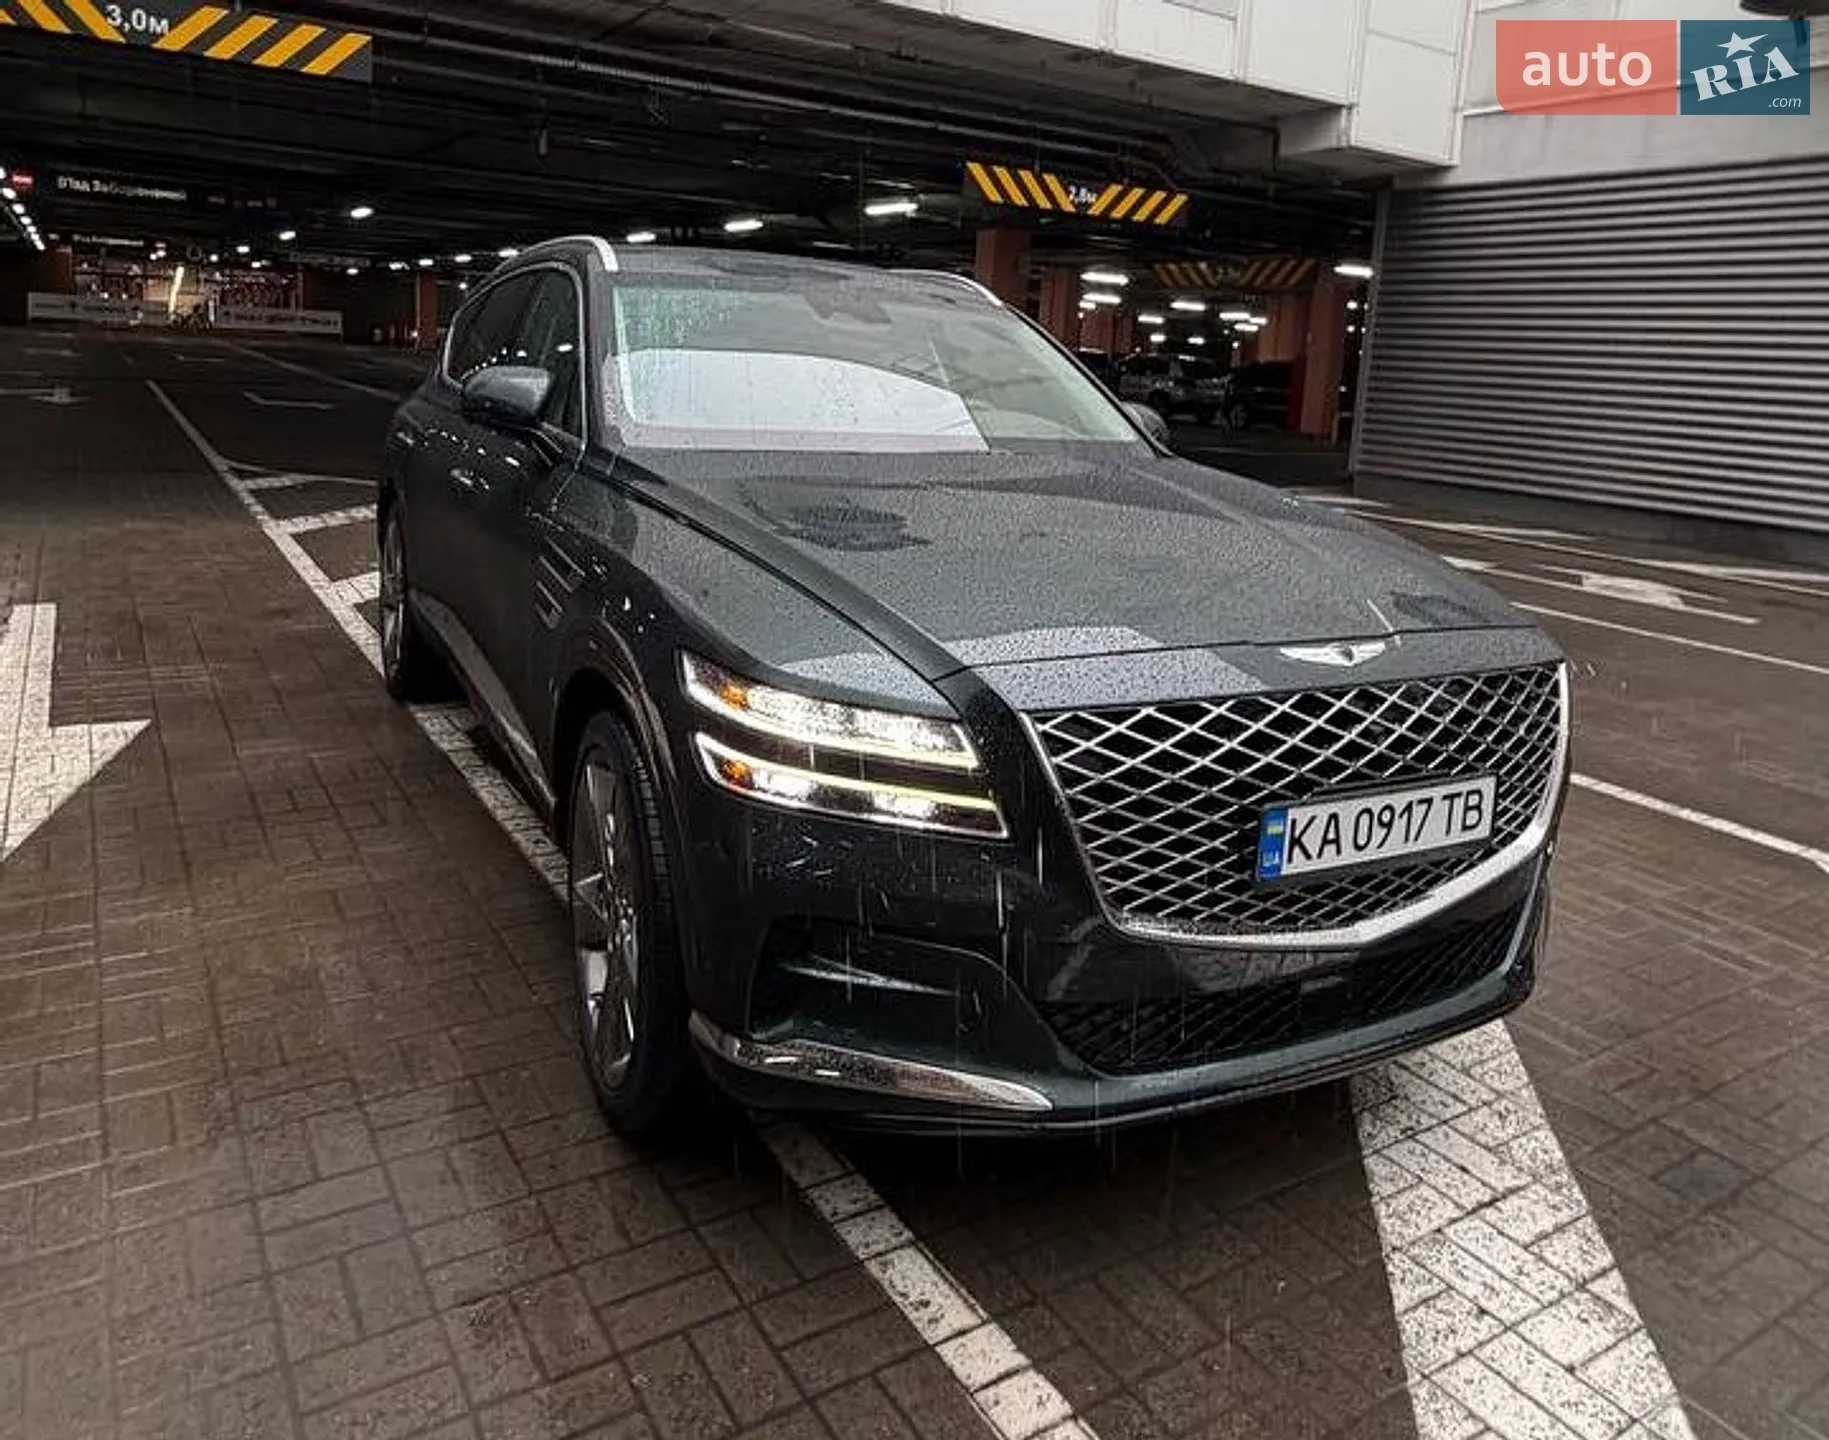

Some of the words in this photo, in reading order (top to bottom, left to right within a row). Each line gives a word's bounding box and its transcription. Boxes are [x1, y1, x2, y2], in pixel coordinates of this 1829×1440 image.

[1286, 812, 1342, 864] KA
[1352, 797, 1434, 851] 0917
[1442, 789, 1484, 836] TB
